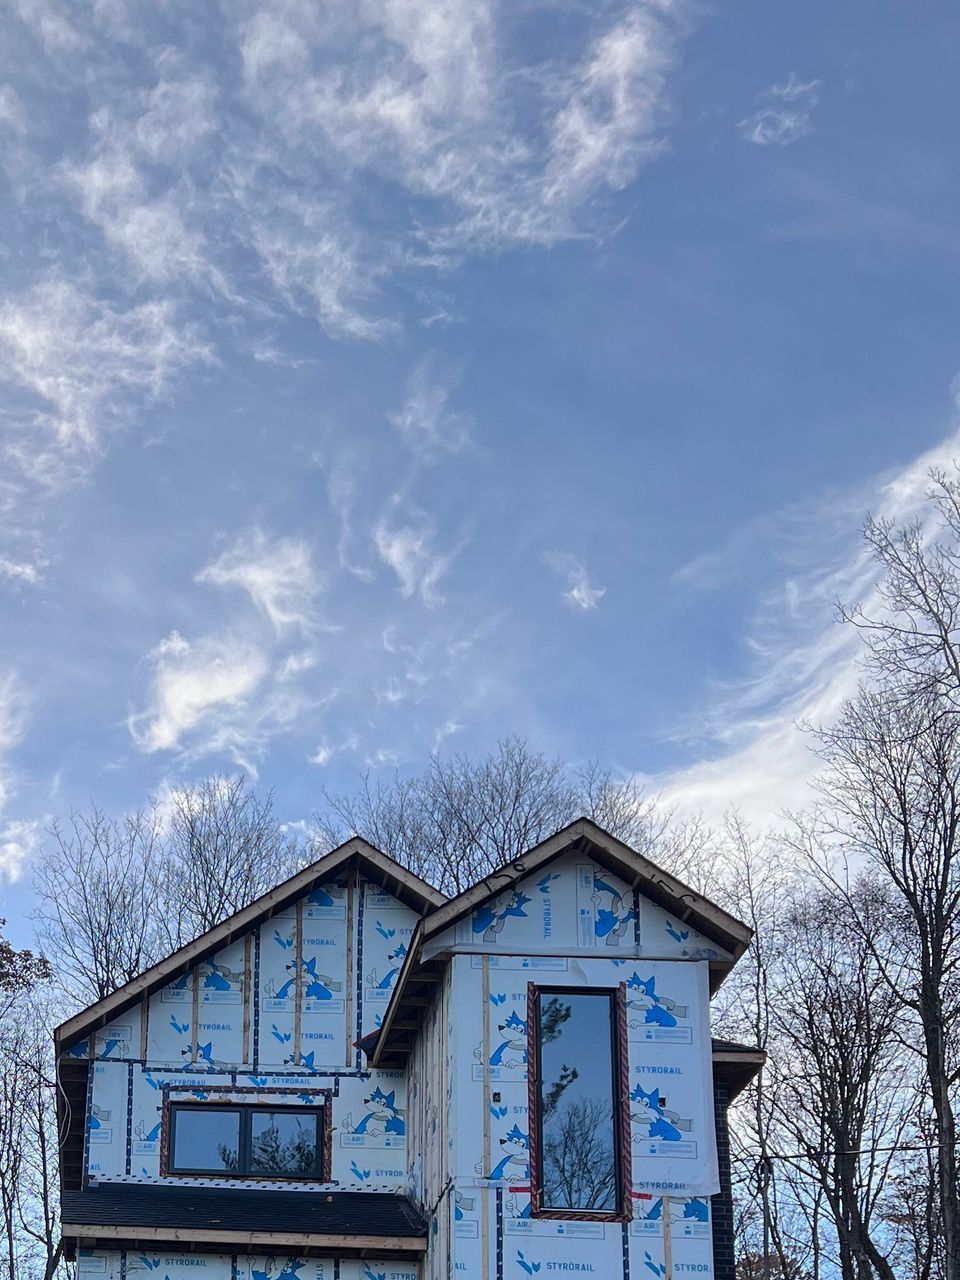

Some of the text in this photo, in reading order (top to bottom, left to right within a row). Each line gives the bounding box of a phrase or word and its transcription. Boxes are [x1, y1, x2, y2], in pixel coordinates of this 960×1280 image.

[543, 898, 552, 938] STYRORAIL
[303, 938, 336, 946] TYRORAIL
[198, 1022, 232, 1031] TYRORAIL
[301, 1032, 335, 1040] TYRORAIL
[635, 1065, 683, 1075] STYRORAIL
[272, 1077, 312, 1085] STYRORAIL
[639, 1181, 688, 1191] STYRORAIL
[165, 1258, 207, 1267] STYRORAIL
[546, 1262, 595, 1272] STYRORAIL
[675, 1263, 710, 1272] STYROR
